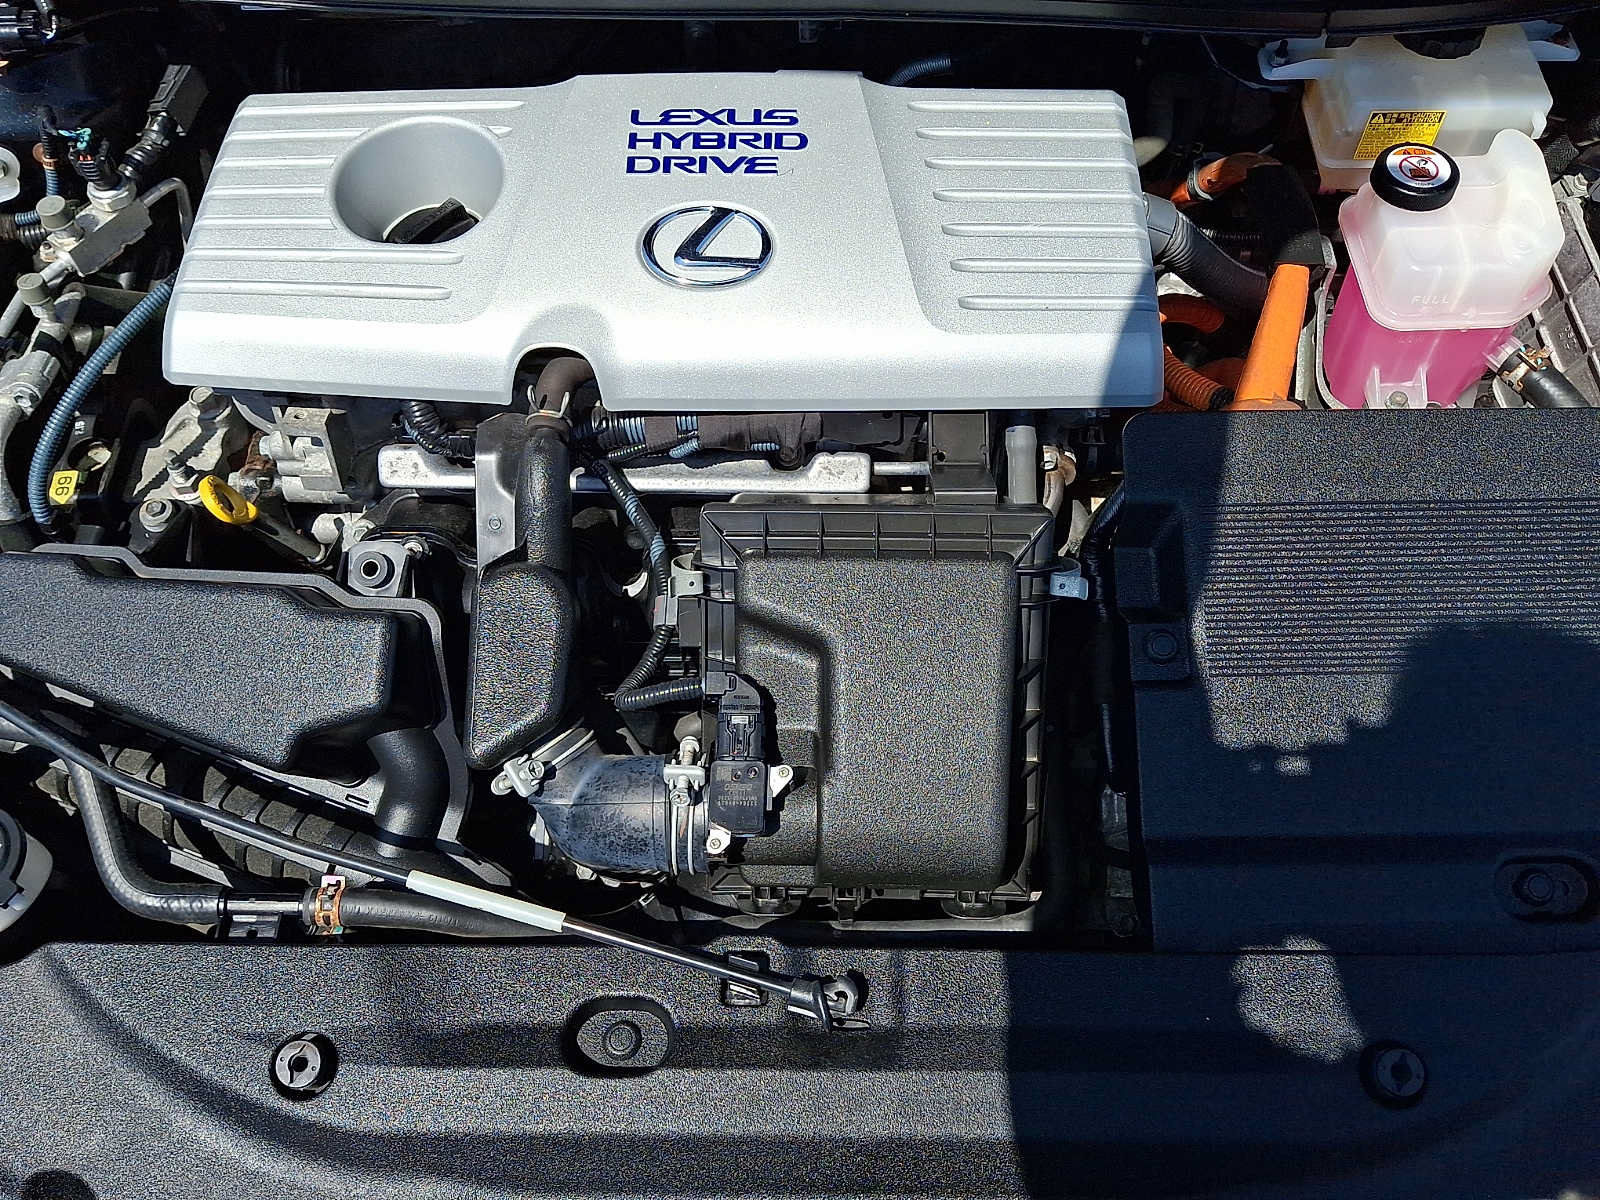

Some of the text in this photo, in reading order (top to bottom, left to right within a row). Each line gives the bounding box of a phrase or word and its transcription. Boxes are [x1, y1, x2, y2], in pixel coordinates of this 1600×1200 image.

[630, 108, 800, 126] LEXUS
[627, 131, 809, 150] HYBRID
[625, 155, 779, 174] DRIVE
[1410, 295, 1449, 305] FULL
